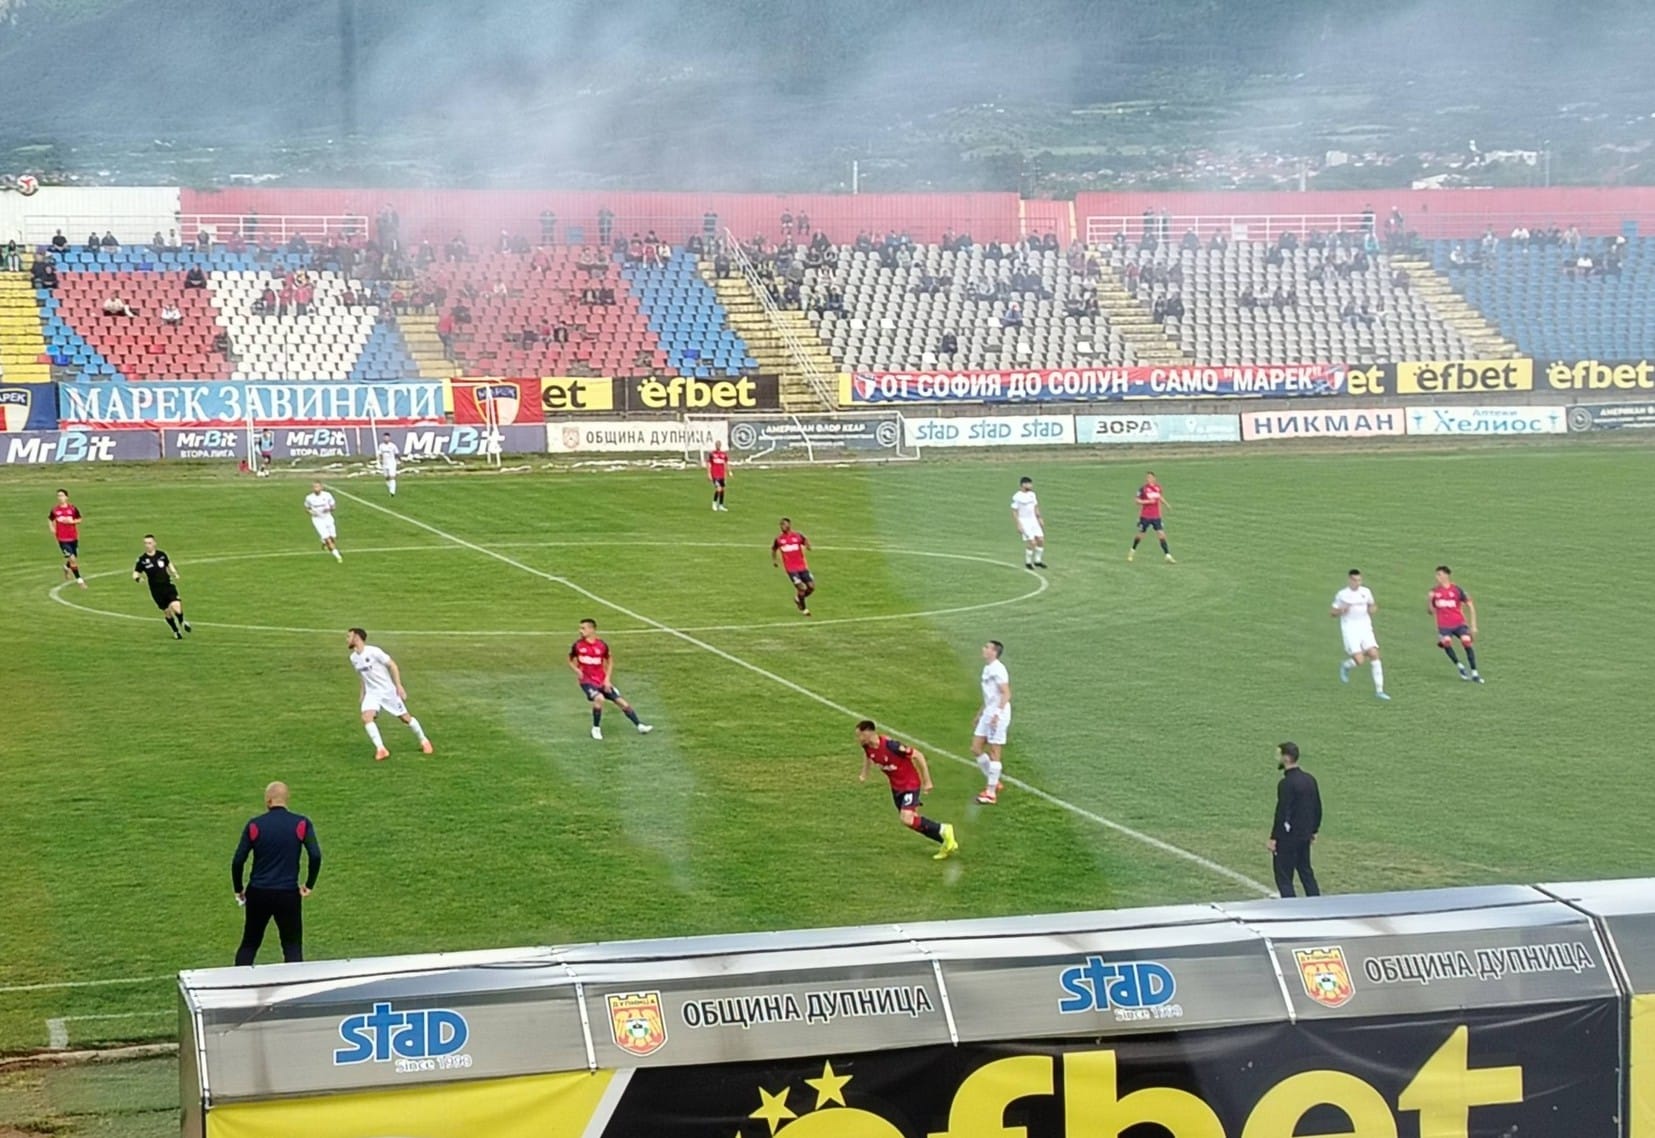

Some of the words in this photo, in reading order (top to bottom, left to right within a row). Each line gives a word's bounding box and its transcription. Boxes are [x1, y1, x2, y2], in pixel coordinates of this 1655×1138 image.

[880, 374, 912, 397] ОТ
[917, 374, 1001, 398] СОФИЯ
[1007, 372, 1042, 398] ДО
[1048, 370, 1128, 396] СОЛУН
[1150, 369, 1218, 393] САМО
[1223, 366, 1322, 392] "МАРЕК"
[1414, 363, 1517, 390] efbet
[65, 386, 211, 422] МАРЕК
[218, 384, 441, 421] ЗАВИНАГИ
[638, 376, 757, 408] efbet
[1096, 420, 1152, 435] ЗОРА
[1254, 414, 1393, 435] НИКМАН
[1433, 409, 1542, 432] Хелиос
[6, 432, 117, 463] MrBit
[177, 430, 238, 447] MrBit
[286, 428, 345, 446] MrBit
[585, 430, 645, 446] ОБЩИНА
[1364, 950, 1475, 985] ОБЩИНА
[1474, 942, 1595, 981] ДУПНИЦА
[682, 994, 802, 1029] ОБЩИНА
[805, 985, 933, 1024] ДУПНИЦА
